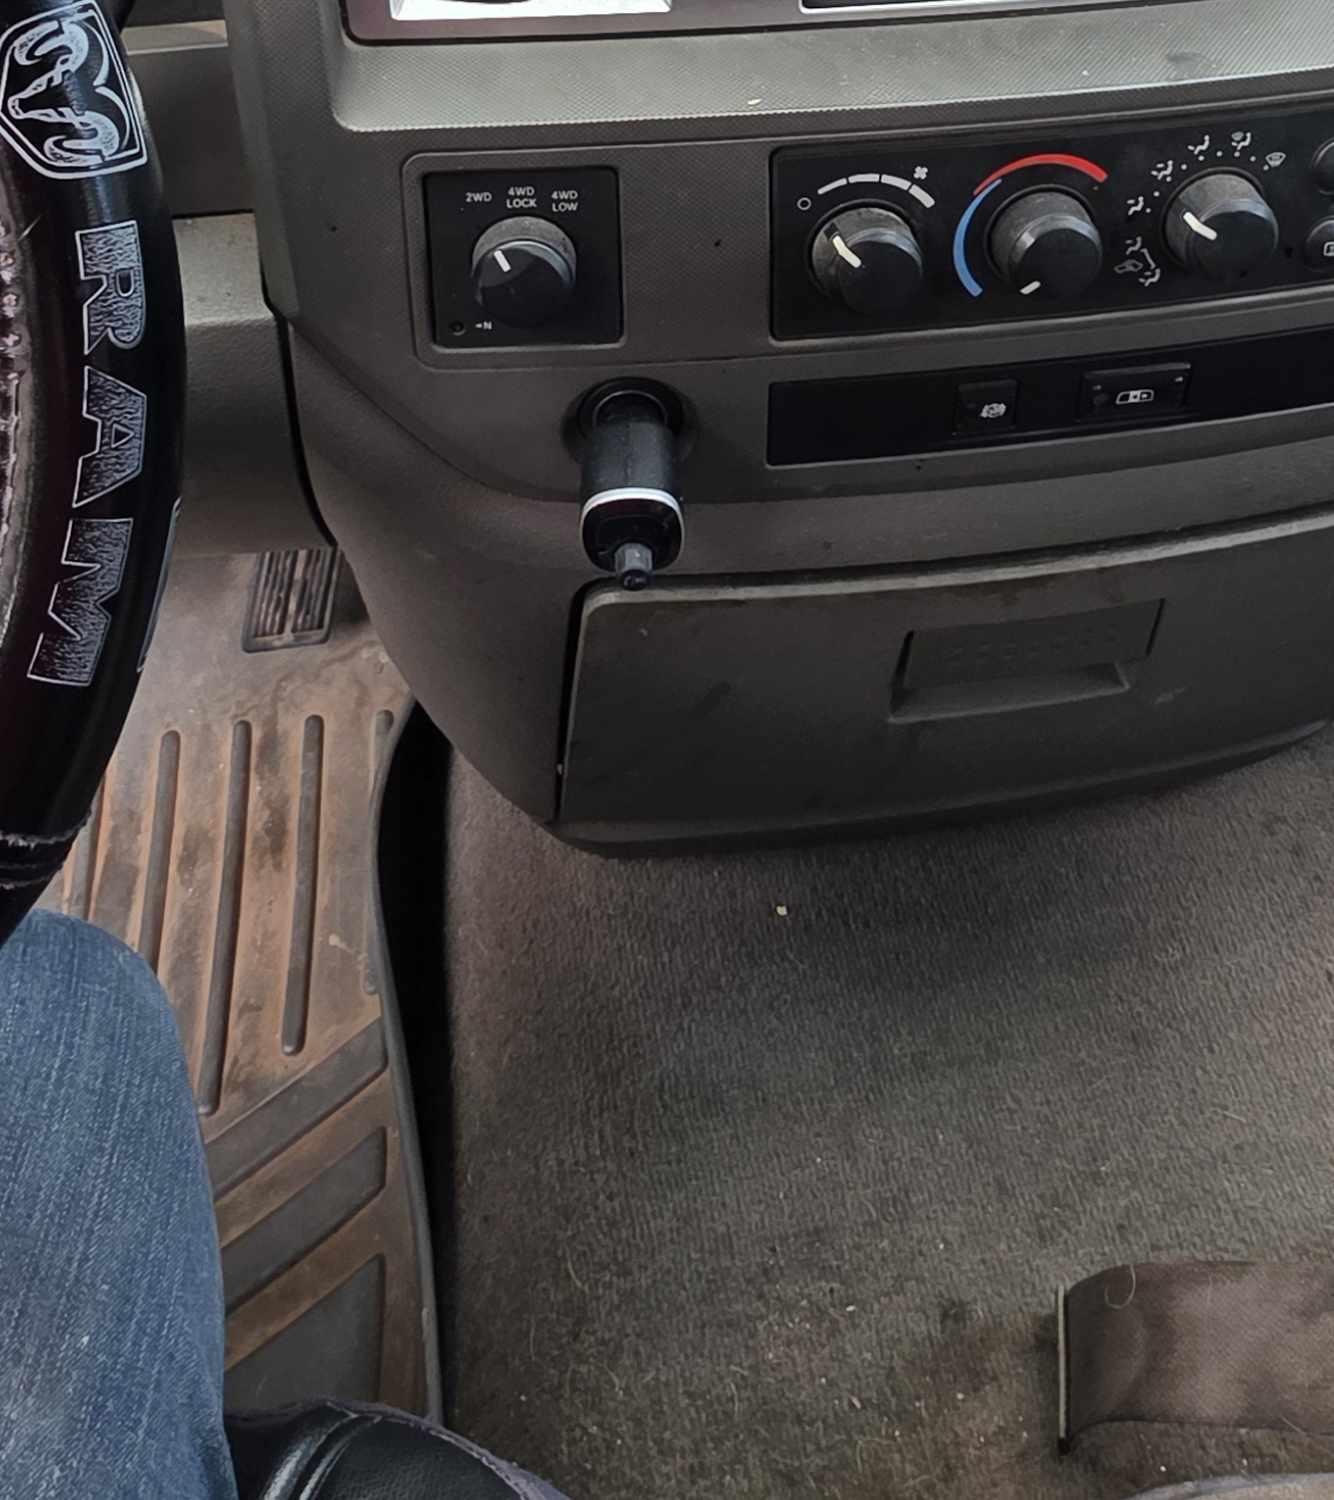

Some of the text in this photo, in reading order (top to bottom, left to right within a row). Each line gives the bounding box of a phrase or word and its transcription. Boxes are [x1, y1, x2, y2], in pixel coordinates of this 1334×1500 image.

[508, 186, 535, 196] 4WD
[551, 190, 578, 200] 4WD
[466, 192, 492, 202] 2WD
[506, 198, 537, 209] LOCK
[552, 202, 578, 212] LOW
[483, 321, 492, 330] N
[27, 220, 147, 686] RAM
